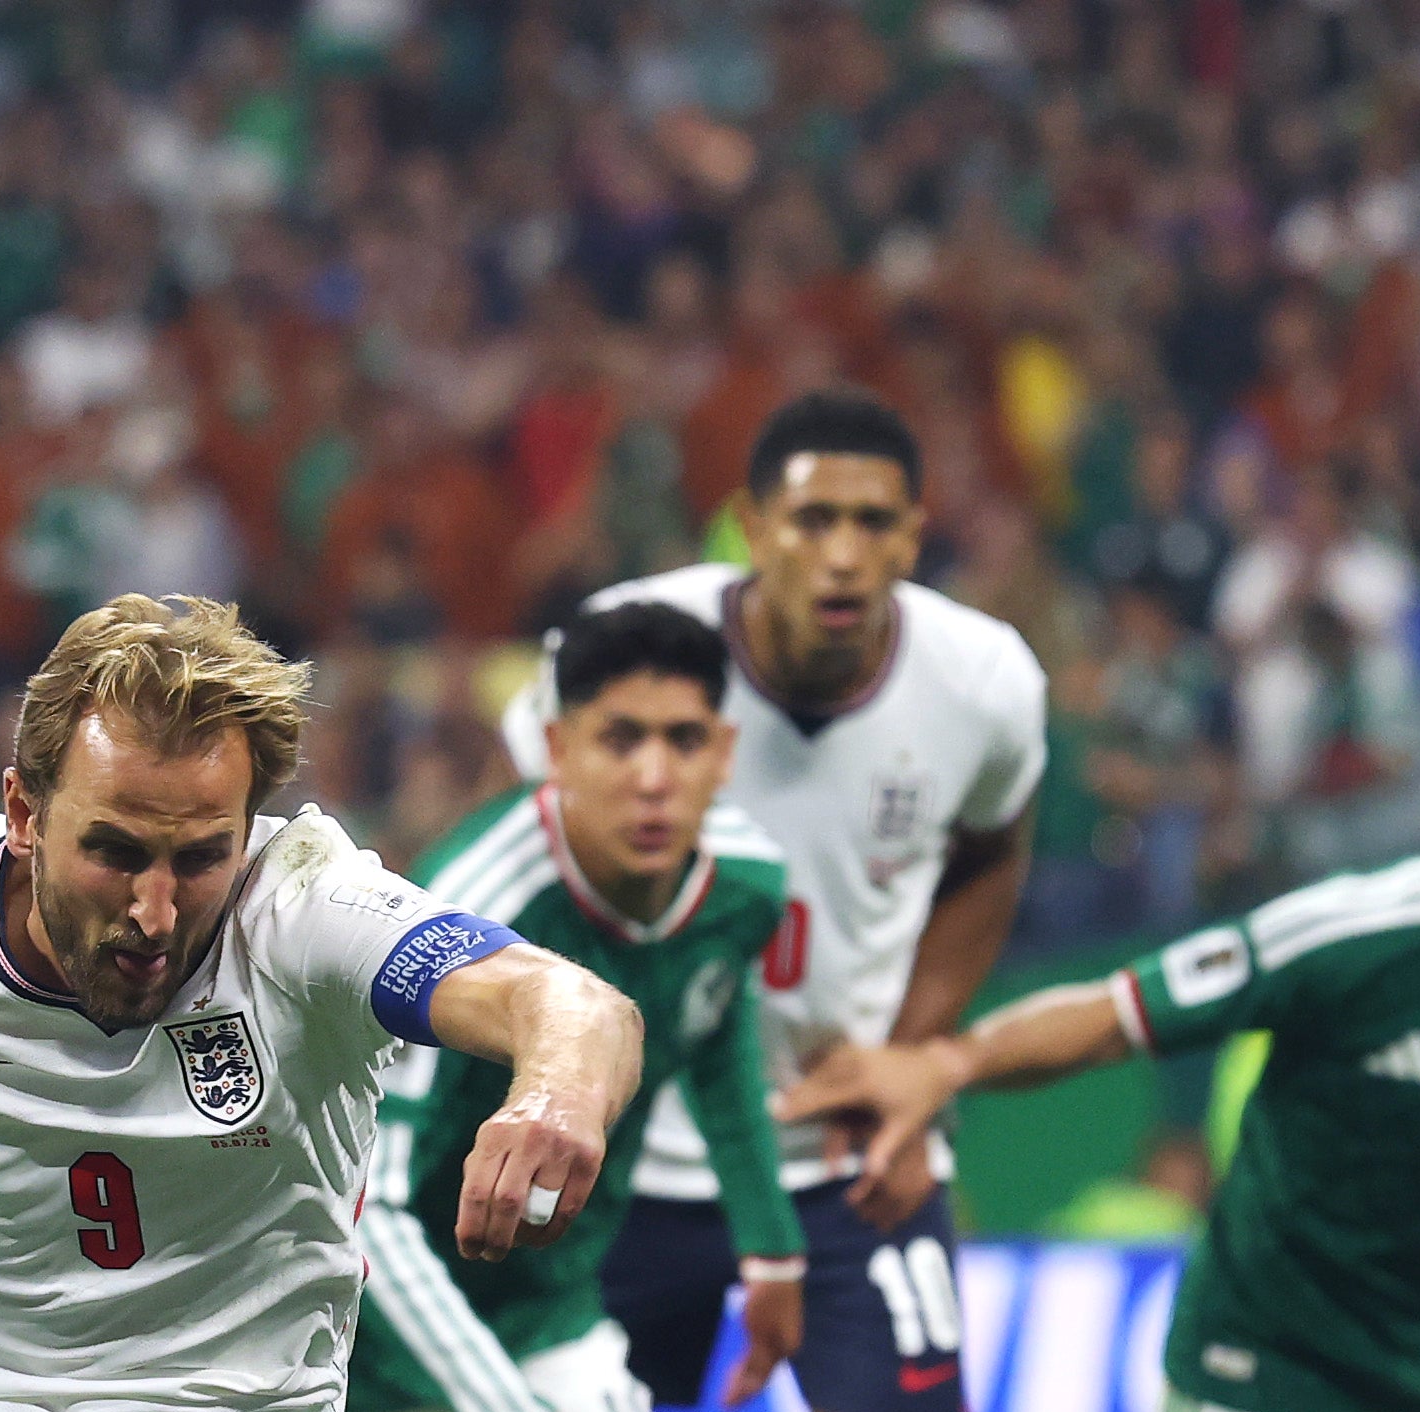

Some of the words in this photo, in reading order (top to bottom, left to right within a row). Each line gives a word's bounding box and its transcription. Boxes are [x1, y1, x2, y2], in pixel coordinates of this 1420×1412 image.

[380, 921, 458, 989] FOOTBALL
[391, 926, 471, 995] UNITES
[405, 972, 430, 1003] the
[427, 930, 487, 969] World
[68, 1151, 146, 1270] 9
[868, 1237, 959, 1355] 10
